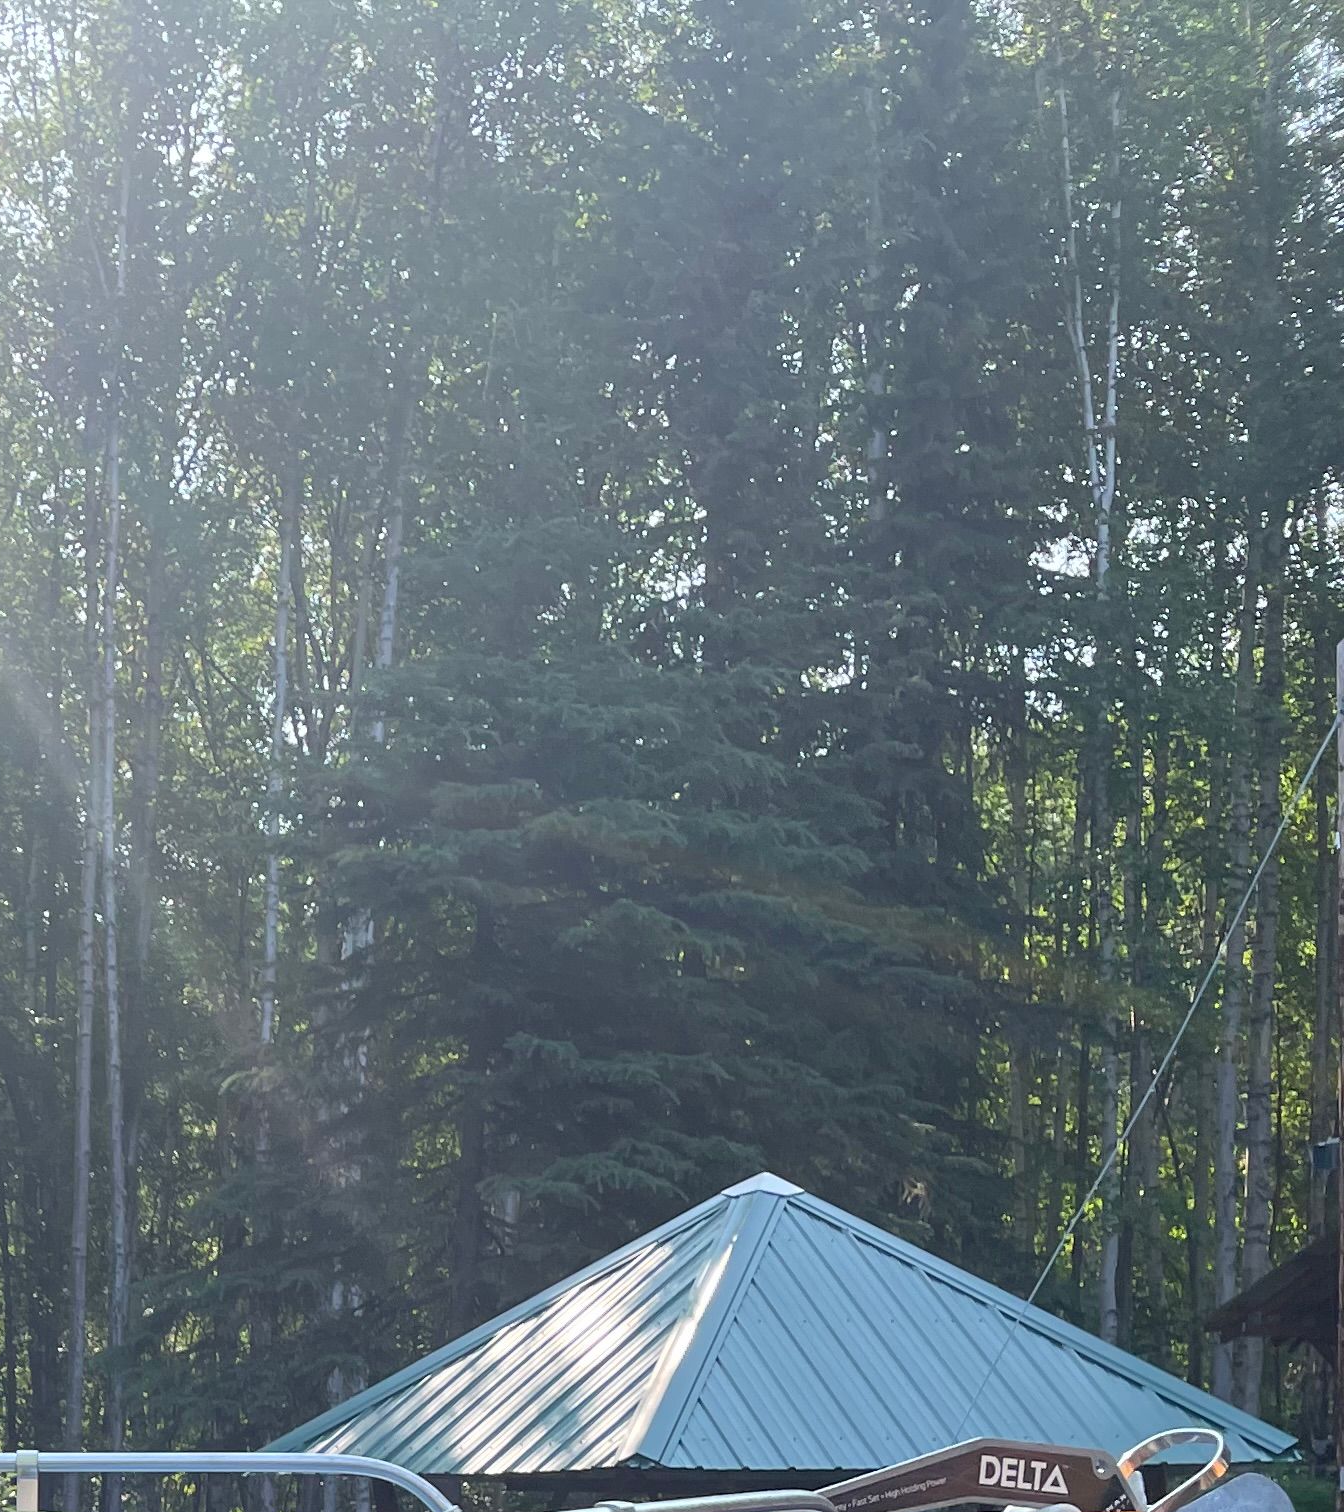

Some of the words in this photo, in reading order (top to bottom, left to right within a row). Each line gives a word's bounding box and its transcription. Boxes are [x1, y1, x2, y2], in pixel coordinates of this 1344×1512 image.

[885, 1489, 901, 1499] High
[927, 1477, 947, 1488] Power
[979, 1454, 1069, 1495] DELTA
